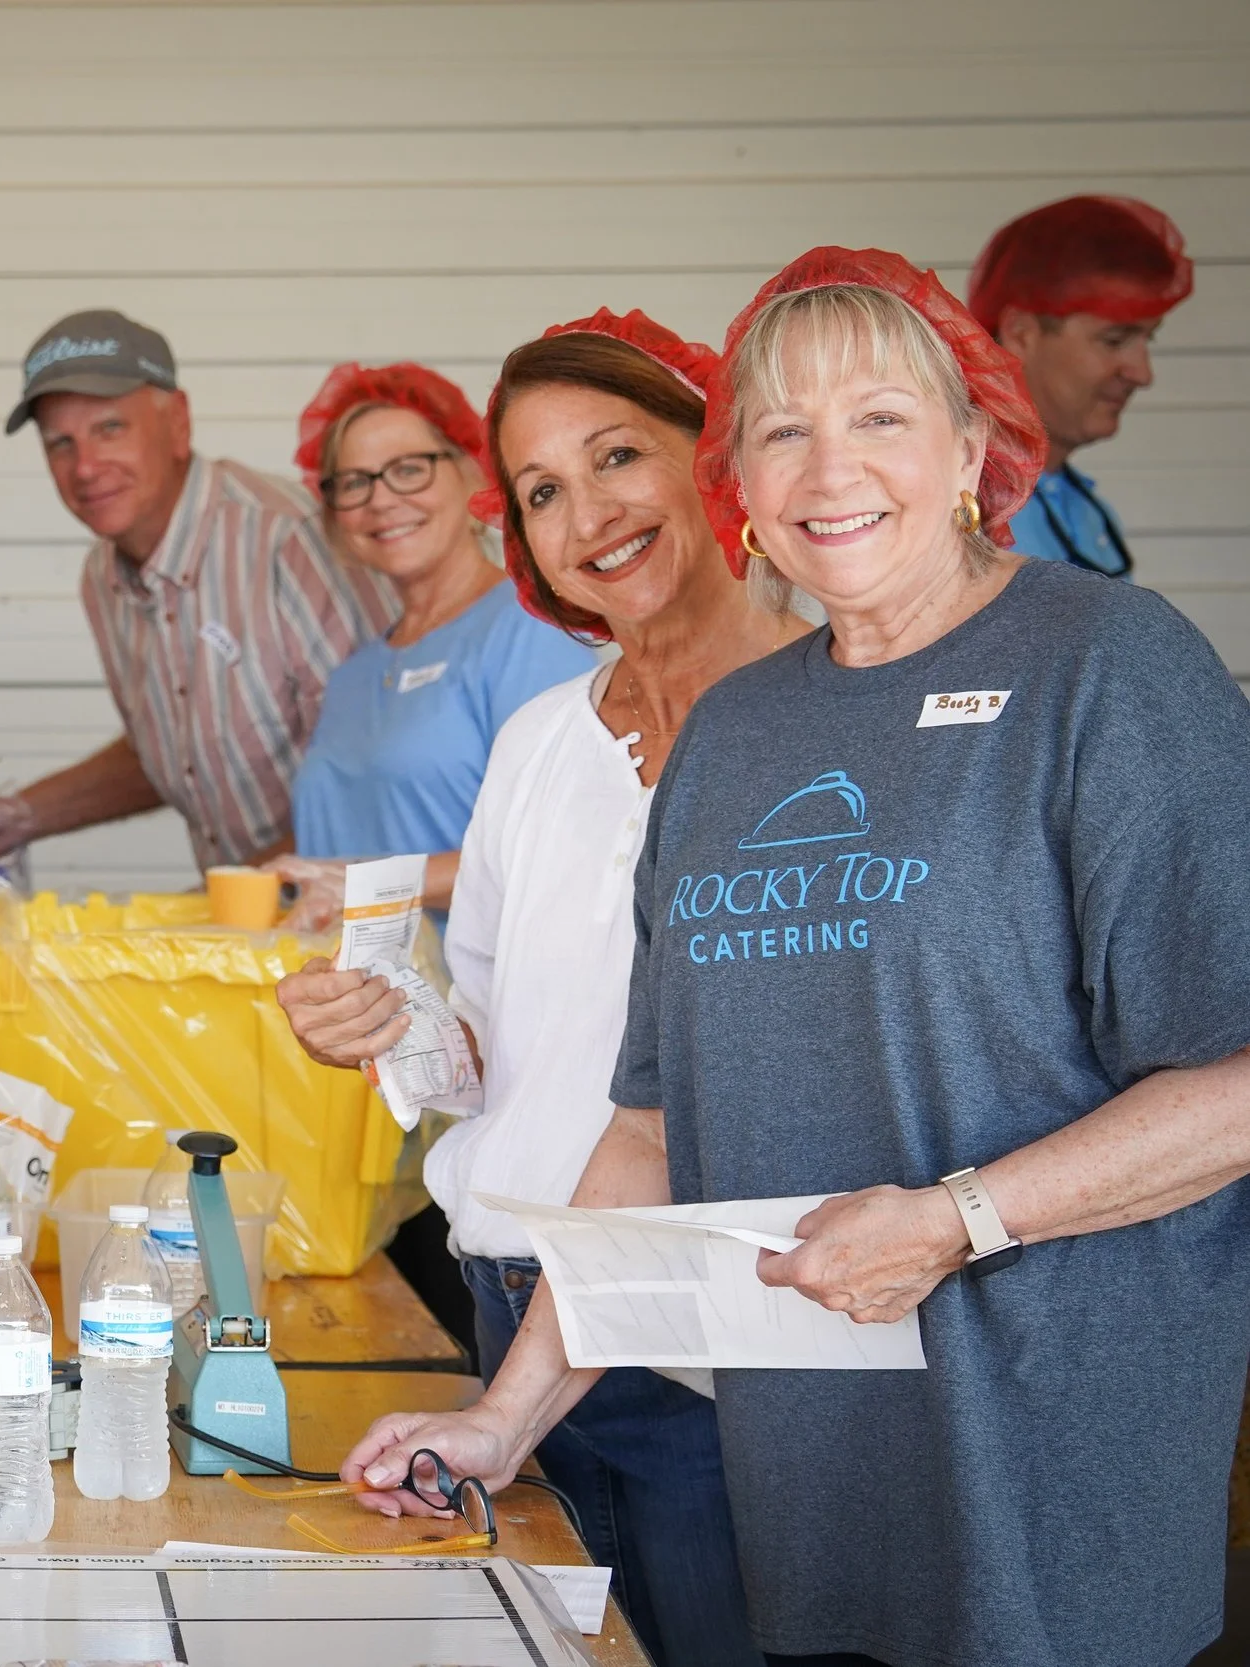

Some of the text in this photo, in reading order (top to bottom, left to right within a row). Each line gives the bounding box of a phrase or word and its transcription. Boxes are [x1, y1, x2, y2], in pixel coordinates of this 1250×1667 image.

[668, 852, 931, 927] ROCKY TOP
[689, 918, 870, 964] CATERING
[105, 1312, 163, 1321] THIRSER
